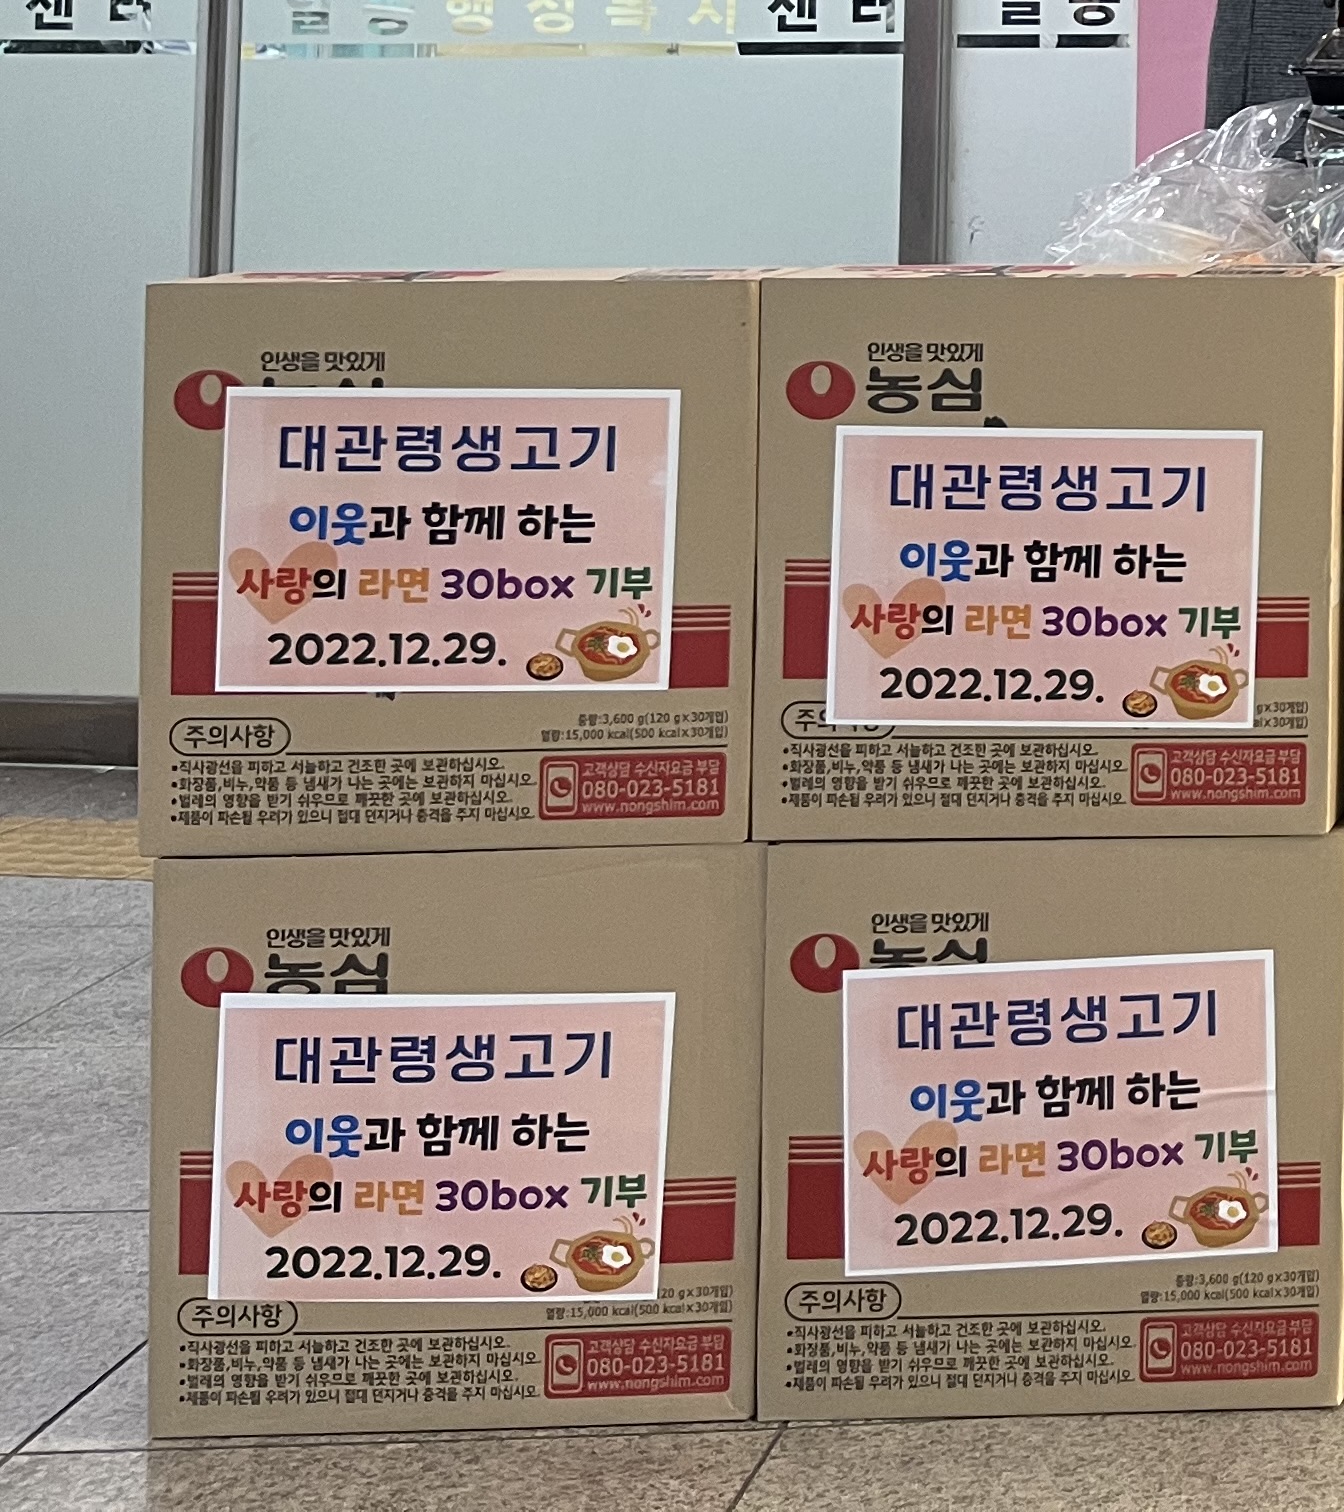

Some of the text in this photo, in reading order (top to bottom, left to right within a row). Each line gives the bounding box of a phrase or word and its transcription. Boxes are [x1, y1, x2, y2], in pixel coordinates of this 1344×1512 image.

[867, 342, 983, 363] 인생을 맛있게
[866, 366, 982, 414] 농심
[279, 425, 616, 472] 대관령생고기
[890, 464, 1205, 512] 대관령생고기
[289, 501, 596, 545] 이웃과 함께 하는
[900, 540, 1187, 583] 이웃과 함께 하는
[237, 566, 653, 605] 사랑의 라면 30box 기부
[851, 603, 1241, 640] 사랑의 라면 30box 기부
[268, 632, 506, 667] 2022.12.29.
[880, 667, 1104, 703] 2022.12.29.
[184, 724, 275, 749] 주의사항
[179, 757, 505, 775] 직사광선을 피하고 서늘하고 건조한 곳에 보관하십시오.
[582, 759, 720, 778] 고객상담 수신자요금 부담
[581, 799, 720, 816] www.nongshim.com
[582, 778, 719, 799] 080-023-5181
[898, 990, 1216, 1051] 대관령생고기
[275, 1032, 610, 1084] 대관령생고기
[285, 1112, 590, 1158] 이웃과 함께 하는
[234, 1175, 647, 1218] 사랑의 라면 30box 기부
[265, 1244, 501, 1280] 2022.12.29.
